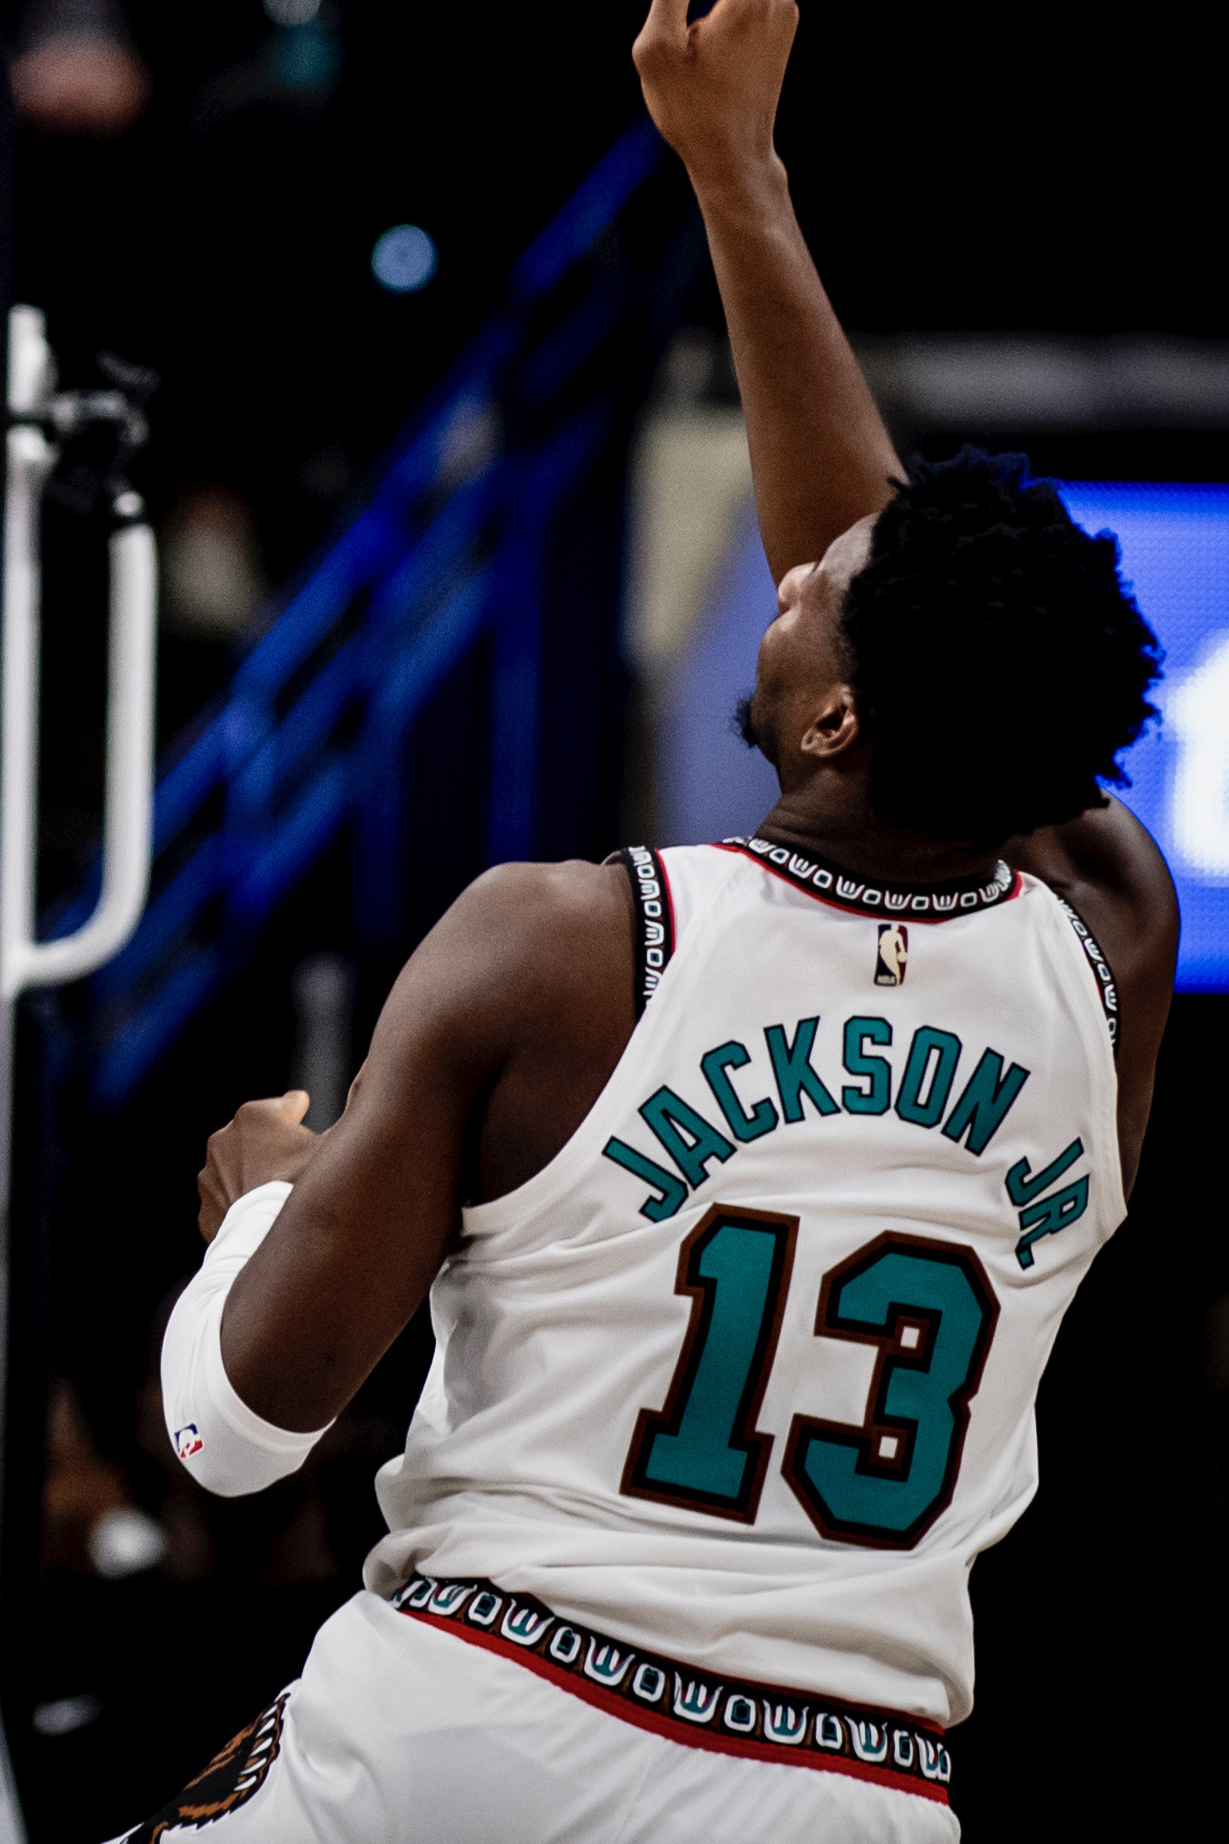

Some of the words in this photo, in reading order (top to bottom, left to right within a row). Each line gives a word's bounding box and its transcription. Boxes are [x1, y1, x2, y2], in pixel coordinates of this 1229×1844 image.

[602, 1016, 1030, 1222] JACKSON
[1005, 1138, 1090, 1270] JR.
[619, 1202, 1001, 1550] 13
